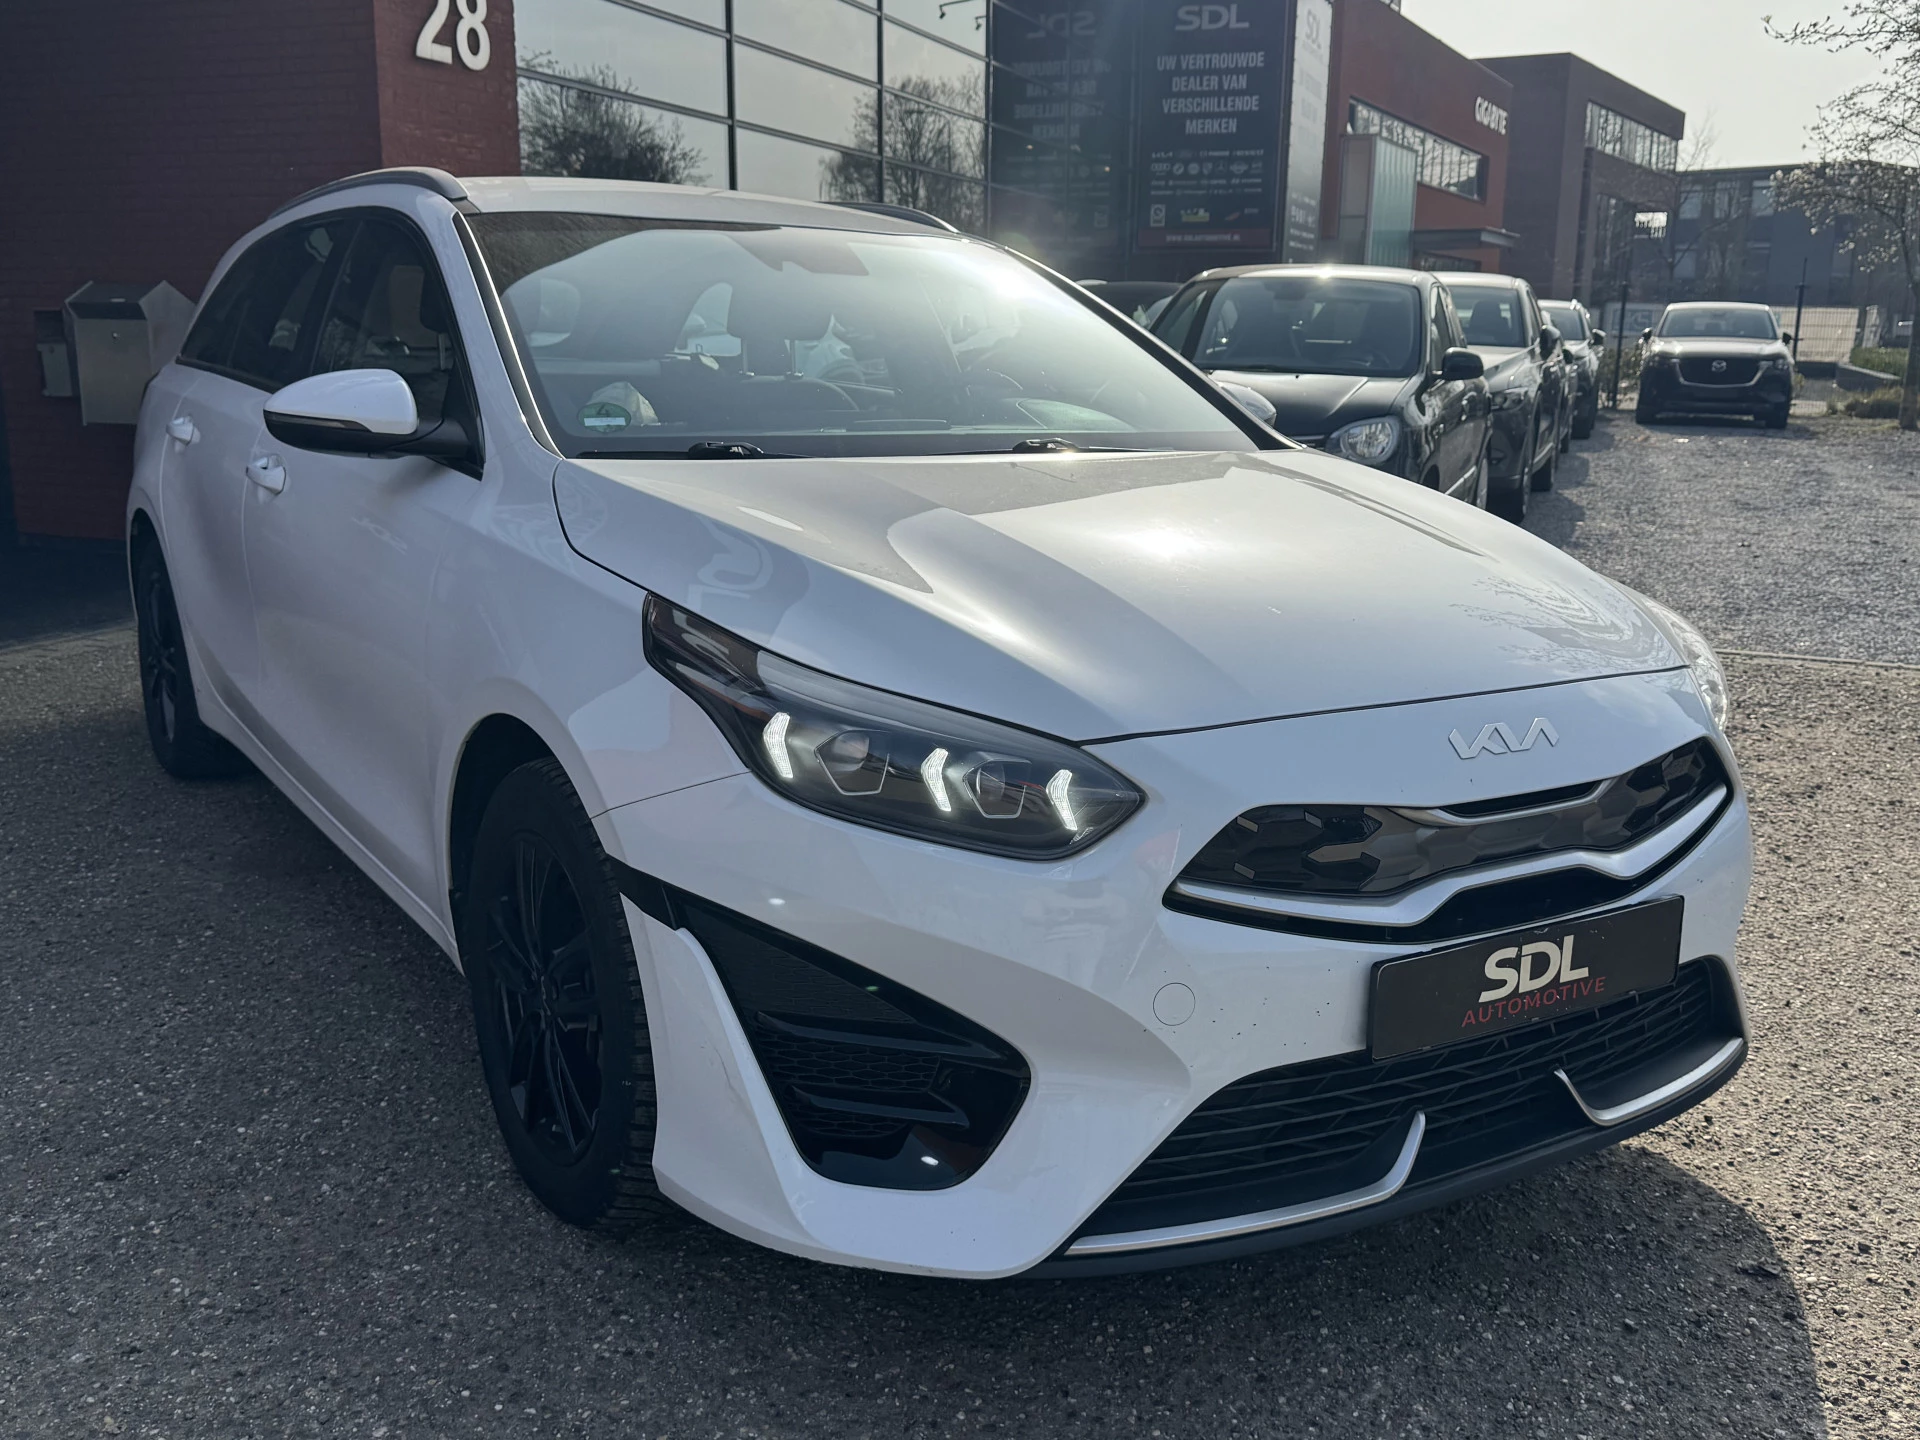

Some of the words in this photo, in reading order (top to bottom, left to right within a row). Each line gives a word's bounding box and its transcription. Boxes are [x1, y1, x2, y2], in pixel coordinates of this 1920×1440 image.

[1175, 3, 1249, 31] SDL
[416, 0, 490, 71] 28
[1157, 55, 1177, 71] UW
[1181, 51, 1265, 70] VERTROUWDE
[1172, 75, 1219, 92] DEALER
[1222, 73, 1248, 91] VAN
[1162, 95, 1260, 114] VERSCHILLENDE
[1185, 118, 1237, 135] MERKEN
[1449, 718, 1560, 760] KIA
[1478, 935, 1590, 1003] SDL
[1461, 977, 1606, 1028] AUTOMOTIVE
